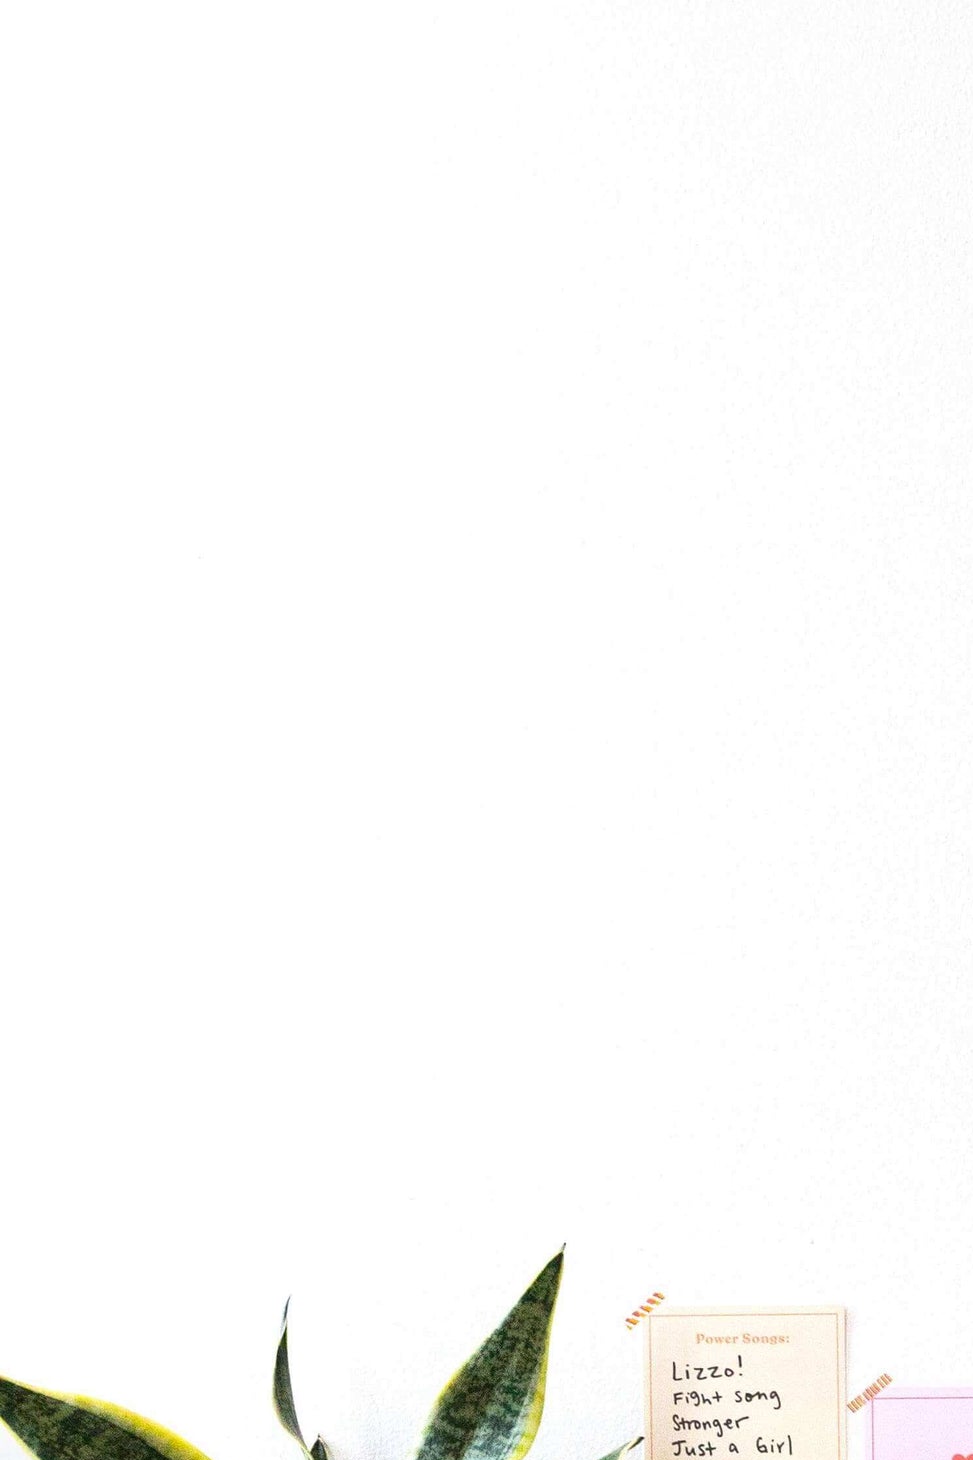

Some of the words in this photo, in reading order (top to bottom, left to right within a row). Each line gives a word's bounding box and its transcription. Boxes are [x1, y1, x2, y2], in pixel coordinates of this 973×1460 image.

[695, 1333, 738, 1345] Power
[742, 1333, 790, 1346] Songs:
[673, 1355, 743, 1381] Lizzo!
[673, 1391, 722, 1407] Fight
[672, 1414, 749, 1438] Stronger
[672, 1440, 716, 1456] Just
[729, 1443, 739, 1453] a
[756, 1435, 792, 1455] Girl
